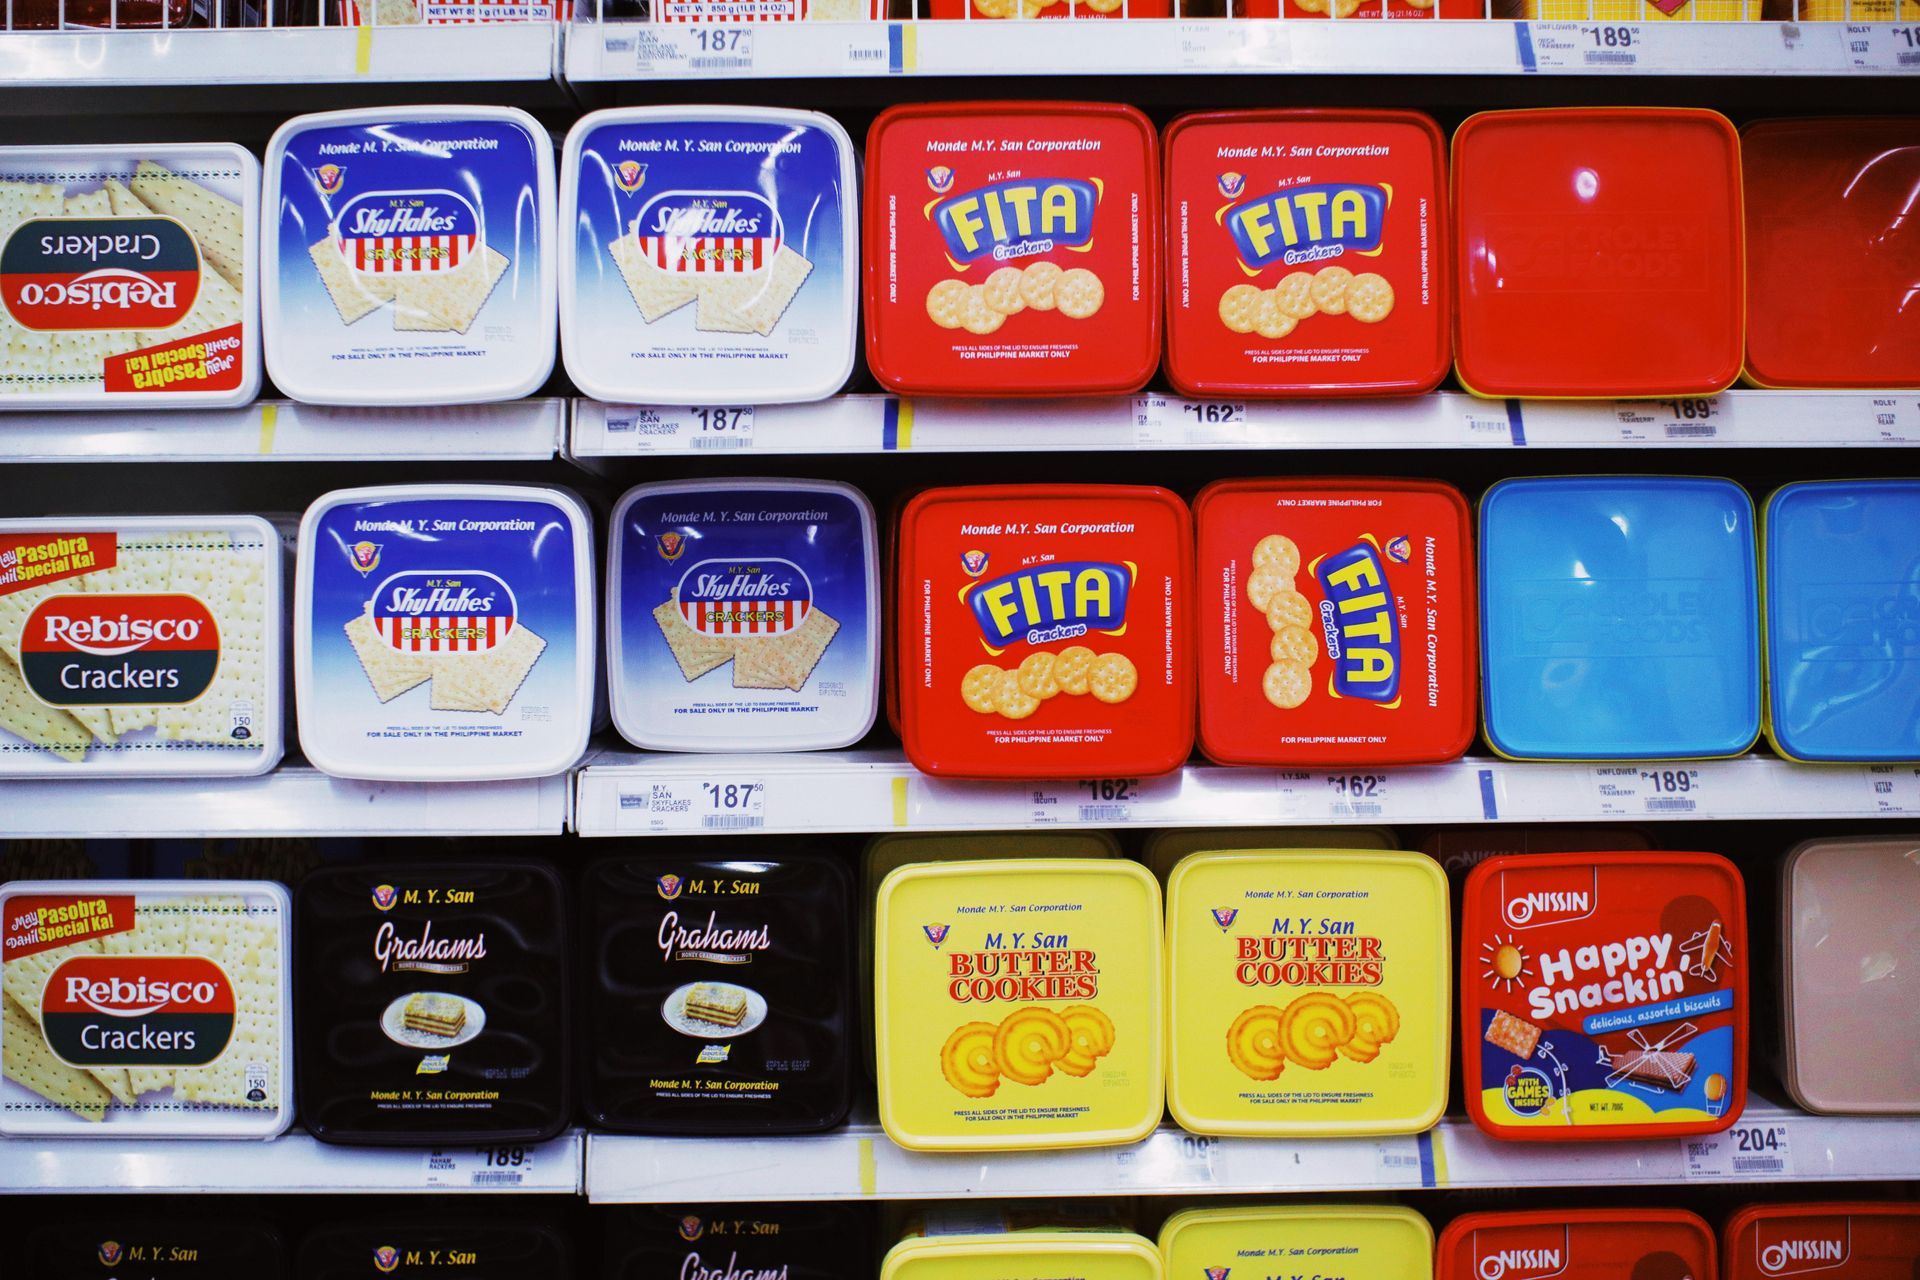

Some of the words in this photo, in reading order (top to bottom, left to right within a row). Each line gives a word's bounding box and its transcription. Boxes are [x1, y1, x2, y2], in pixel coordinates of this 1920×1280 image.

[711, 5, 727, 13] 850
[729, 6, 734, 14] g
[760, 4, 768, 12] 14
[771, 3, 787, 13] OZ)
[926, 140, 967, 152] Monde
[1000, 140, 1023, 151] San
[1026, 139, 1101, 152] Corporation
[349, 207, 457, 236] SkyFlakes
[948, 184, 1077, 254] FITA
[1239, 190, 1367, 258] FITA
[41, 234, 161, 261] Crackers
[365, 247, 449, 261] CRACKERS
[994, 239, 1052, 260] Crackers
[1284, 243, 1344, 266] Crackers
[20, 267, 177, 311] Rebisco
[125, 353, 151, 374] Ka!
[152, 344, 205, 364] Special
[133, 360, 208, 389] Pasobra
[400, 519, 414, 531] M.
[418, 520, 429, 531] Y.
[432, 520, 456, 531] San
[459, 518, 535, 532] Corporation
[661, 512, 700, 523] Monde
[702, 512, 716, 522] M.
[721, 511, 731, 522] Y.
[733, 511, 756, 521] San
[758, 510, 828, 522] Corporation
[961, 524, 1002, 535] Monde
[1033, 523, 1057, 534] San
[1060, 522, 1135, 535] Corporation
[16, 537, 88, 564] Pasobra
[1040, 553, 1055, 562] San
[1425, 536, 1436, 577] Monde
[17, 557, 70, 582] Special
[72, 551, 95, 569] Ka!
[746, 566, 761, 574] San
[691, 574, 791, 600] SkyFlakes
[386, 587, 495, 616] SkyFlakes
[982, 568, 1110, 638] FITA
[705, 611, 784, 623] CRACKERS
[1327, 557, 1394, 682] FITA
[1426, 608, 1438, 631] San
[44, 614, 202, 656] Rebisco
[401, 628, 487, 640] CRACKERS
[1027, 623, 1087, 645] Crackers
[1319, 599, 1341, 660] Crackers
[61, 662, 179, 689] Crackers
[1426, 634, 1439, 707] Corporation
[232, 716, 251, 727] 150
[754, 783, 764, 791] 50
[404, 890, 421, 903] M.
[428, 890, 440, 903] Y.
[445, 889, 474, 903] San
[689, 880, 707, 894] M.
[713, 880, 725, 893] Y.
[730, 880, 760, 894] San
[11, 911, 39, 931] May
[37, 899, 107, 926] Pasobra
[1029, 903, 1082, 912] Corporation
[38, 919, 90, 942] Special
[91, 913, 114, 931] Ka!
[658, 910, 770, 963] Grahams
[375, 920, 487, 974] Grahams
[985, 933, 1007, 949] M.
[1012, 932, 1025, 949] Y.
[1031, 932, 1068, 948] San
[1236, 936, 1386, 961] BUTTER
[949, 950, 1100, 976] BUTTER
[1539, 933, 1673, 986] Happy
[1236, 960, 1383, 987] COOKIES
[65, 976, 219, 1018] Rebisco
[948, 975, 1098, 1003] COOKIES
[1590, 1015, 1636, 1031] delicious,
[1638, 1005, 1681, 1022] assorted
[1684, 996, 1721, 1013] biscuits
[81, 1024, 195, 1050] Crackers
[248, 1079, 266, 1088] 150
[650, 1080, 679, 1089] Monde
[681, 1080, 692, 1089] M.
[695, 1080, 703, 1089] Y.
[705, 1081, 722, 1090] San
[724, 1080, 779, 1091] Corporation
[1508, 1085, 1549, 1099] GAMES
[1518, 1078, 1539, 1087] WITH
[1514, 1097, 1543, 1107] INSIDE!
[1589, 1103, 1599, 1111] NET
[406, 1252, 424, 1265] M.
[430, 1252, 442, 1265] Y.
[447, 1250, 476, 1265] San
